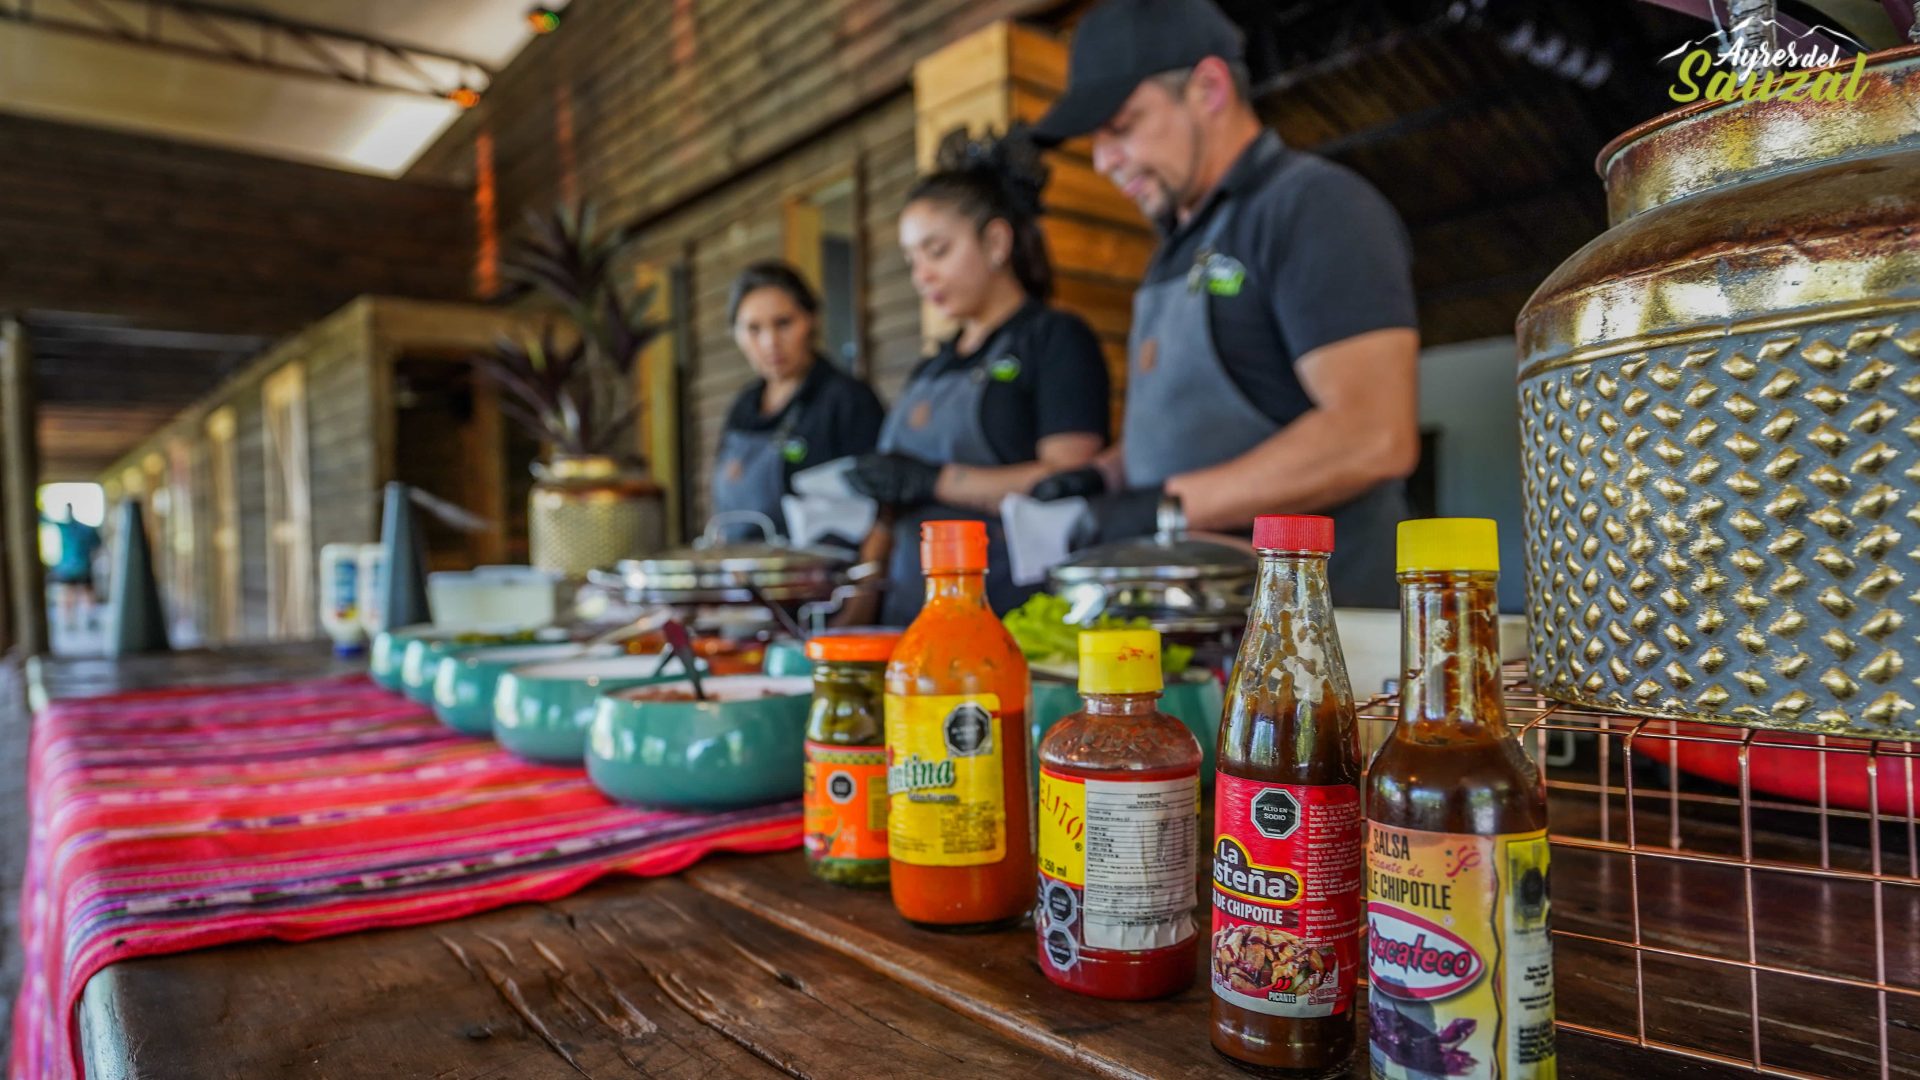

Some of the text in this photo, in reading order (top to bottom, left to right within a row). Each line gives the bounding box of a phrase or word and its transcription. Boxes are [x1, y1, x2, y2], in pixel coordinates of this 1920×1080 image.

[1263, 813, 1287, 821] SODIO
[1220, 841, 1239, 865] La
[1374, 829, 1410, 861] SALSA
[1056, 864, 1068, 878] ml
[1408, 864, 1424, 878] de
[1381, 874, 1451, 910] CHIPOTLE
[1217, 894, 1226, 911] DE
[1227, 898, 1283, 925] CHIPOTLE
[1268, 991, 1296, 1004] PICANTE
